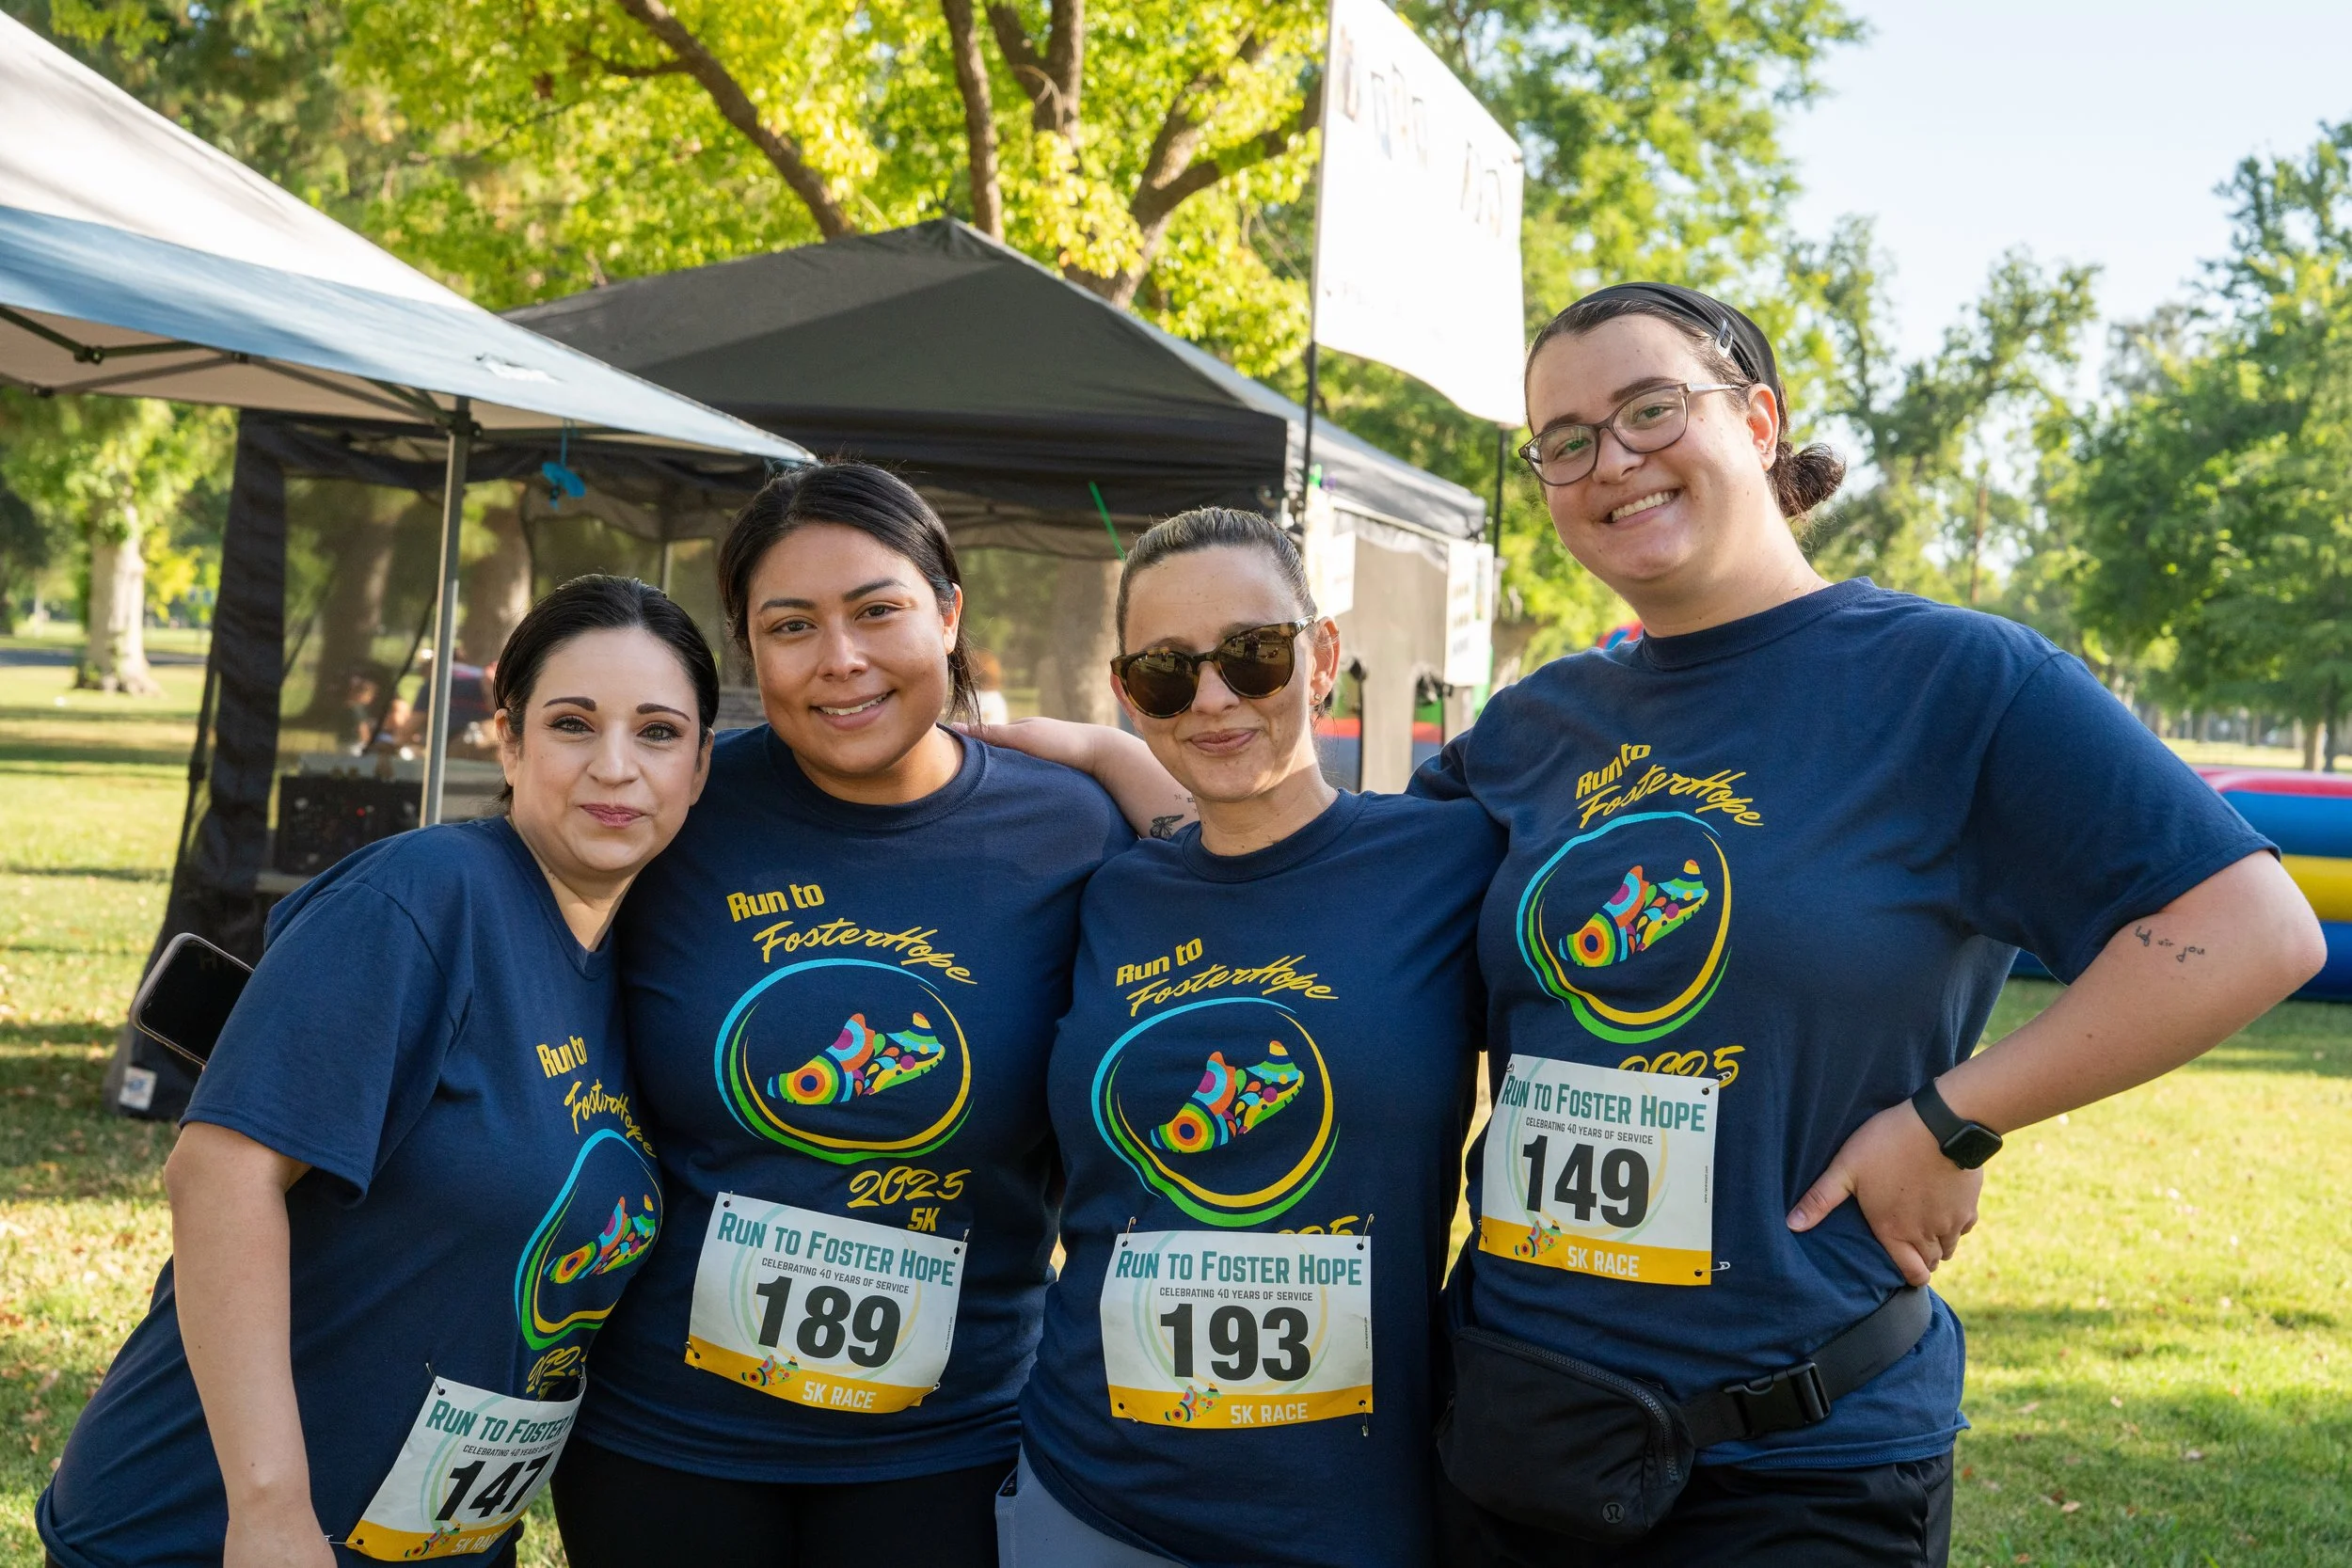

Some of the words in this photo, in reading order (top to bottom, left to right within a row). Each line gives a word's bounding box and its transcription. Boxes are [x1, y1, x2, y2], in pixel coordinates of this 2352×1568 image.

[1576, 756, 1623, 800] Run
[1620, 743, 1651, 768] to
[726, 891, 789, 923] Run
[788, 883, 825, 909] to
[1116, 956, 1170, 987] Run
[1175, 938, 1203, 967] to
[536, 1043, 576, 1079] Run
[568, 1035, 588, 1066] to
[1501, 1075, 1531, 1108] RUN
[1534, 1083, 1552, 1112] TO
[1556, 1084, 1632, 1126] FOSTER
[1641, 1095, 1708, 1132] HOPE
[1525, 1117, 1565, 1132] CELEBRATING
[1566, 1122, 1577, 1134] 40
[1578, 1126, 1602, 1138] YEARS
[1604, 1130, 1615, 1140] OF
[1617, 1132, 1653, 1145] SERVICE
[847, 1165, 971, 1209] 2025
[1522, 1134, 1649, 1228] 149
[907, 1207, 940, 1232] 5K
[717, 1211, 768, 1249] RUN
[774, 1226, 802, 1257] TO
[806, 1231, 895, 1275] FOSTER
[898, 1248, 956, 1287] HOPE
[1115, 1250, 1160, 1279] RUN
[1168, 1254, 1193, 1280] TO
[1201, 1251, 1290, 1285] FOSTER
[1298, 1254, 1362, 1286] HOPE
[1567, 1245, 1588, 1269] 5K
[1594, 1250, 1640, 1277] RACE
[761, 1257, 817, 1276] CELEBRATING
[819, 1268, 832, 1279] 40
[834, 1272, 861, 1285] YEARS
[863, 1277, 874, 1288] OF
[876, 1280, 910, 1294] SERVICE
[1159, 1287, 1215, 1298] CELEBRATING
[1217, 1288, 1230, 1299] 40
[1232, 1290, 1260, 1300] YEARS
[1263, 1291, 1274, 1300] OF
[1277, 1291, 1313, 1302] SERVICE
[755, 1275, 901, 1369] 189
[1160, 1303, 1311, 1382] 193
[803, 1380, 826, 1403] 5K
[830, 1387, 877, 1409] RACE
[1230, 1403, 1254, 1424] 5K
[1261, 1402, 1308, 1422] RACE
[425, 1399, 479, 1438] RUN
[478, 1416, 509, 1442] TO
[505, 1415, 570, 1444] FOSTER
[463, 1445, 509, 1457] CELEBRATING
[510, 1449, 519, 1457] 40
[519, 1447, 540, 1456] YEARS
[435, 1451, 554, 1522] 147
[452, 1537, 475, 1553] 5K
